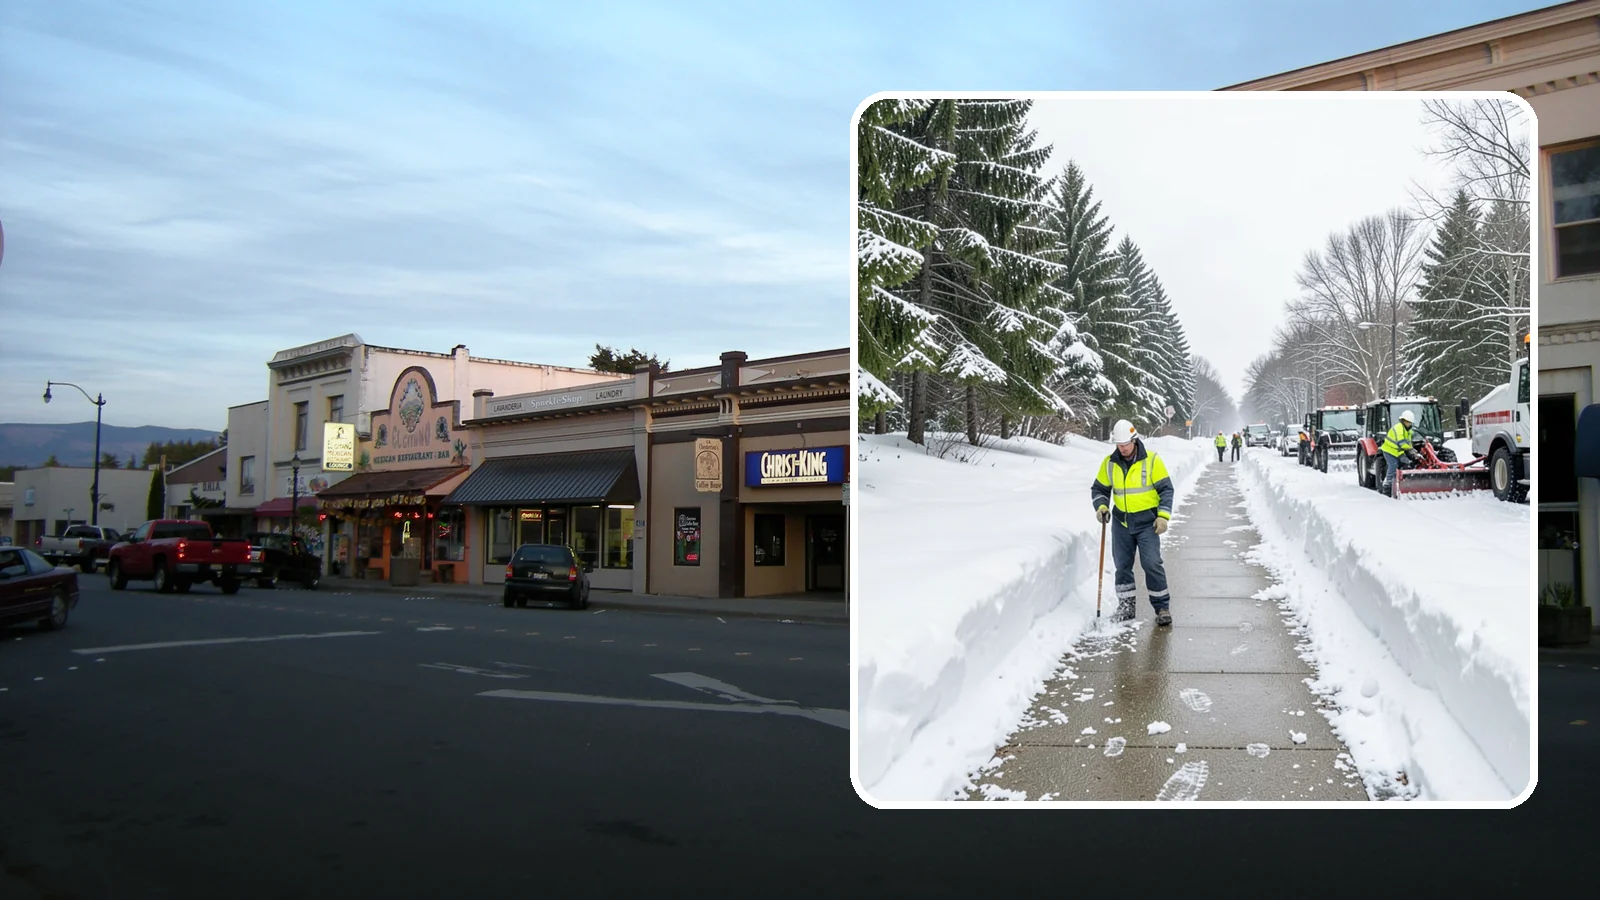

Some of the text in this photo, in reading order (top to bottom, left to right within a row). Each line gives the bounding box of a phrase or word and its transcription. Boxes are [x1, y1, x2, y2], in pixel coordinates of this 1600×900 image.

[530, 394, 582, 409] Sparkle Shop
[595, 389, 623, 400] LAUNDRY
[493, 402, 522, 412] LAVANDERIA
[373, 455, 396, 464] MEXICAN
[397, 451, 433, 462] RESTAURANT
[438, 450, 450, 459] BAR
[761, 450, 827, 478] CHRIST KING
